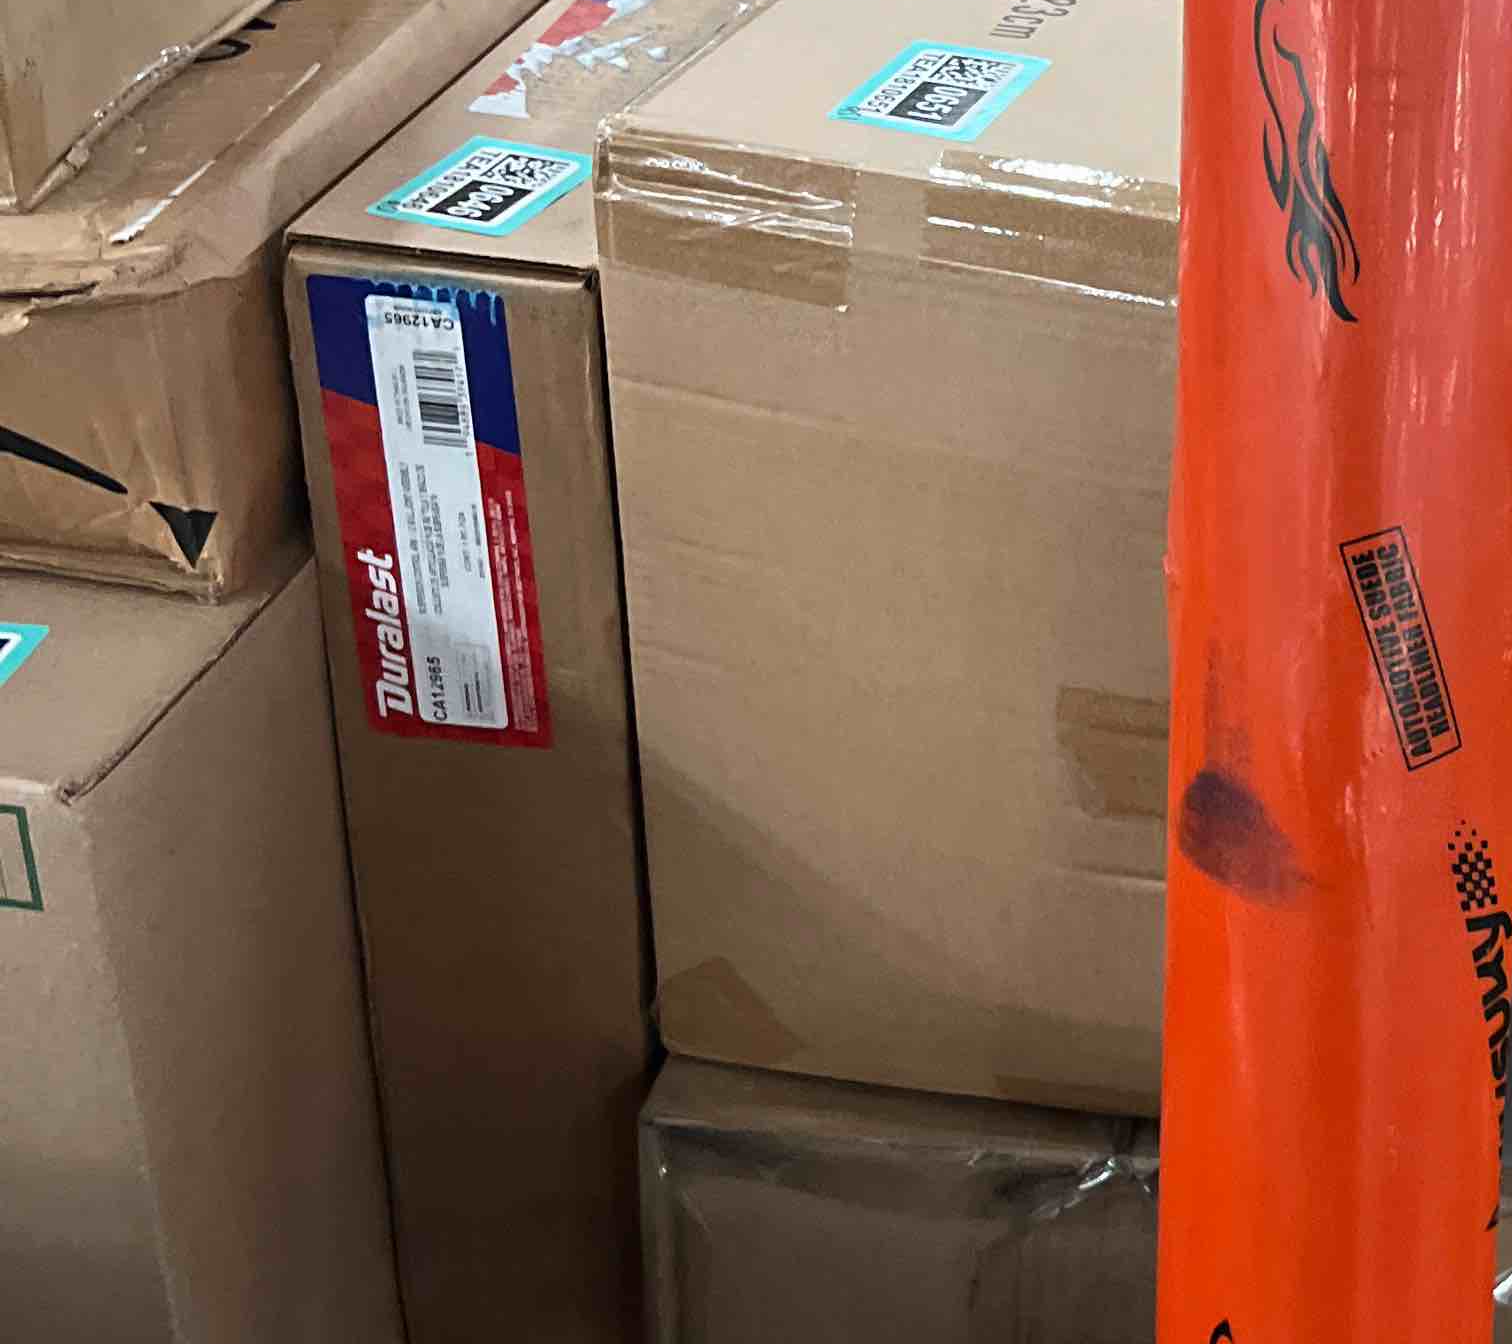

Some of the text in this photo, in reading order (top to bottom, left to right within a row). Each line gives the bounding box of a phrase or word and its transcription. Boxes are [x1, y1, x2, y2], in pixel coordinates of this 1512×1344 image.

[905, 85, 968, 125] 0651
[446, 180, 517, 220] 0646
[383, 310, 455, 331] CA12965
[356, 547, 414, 720] Duralast
[426, 655, 449, 723] CA12965
[1373, 620, 1433, 758] AUTOMOTIVE
